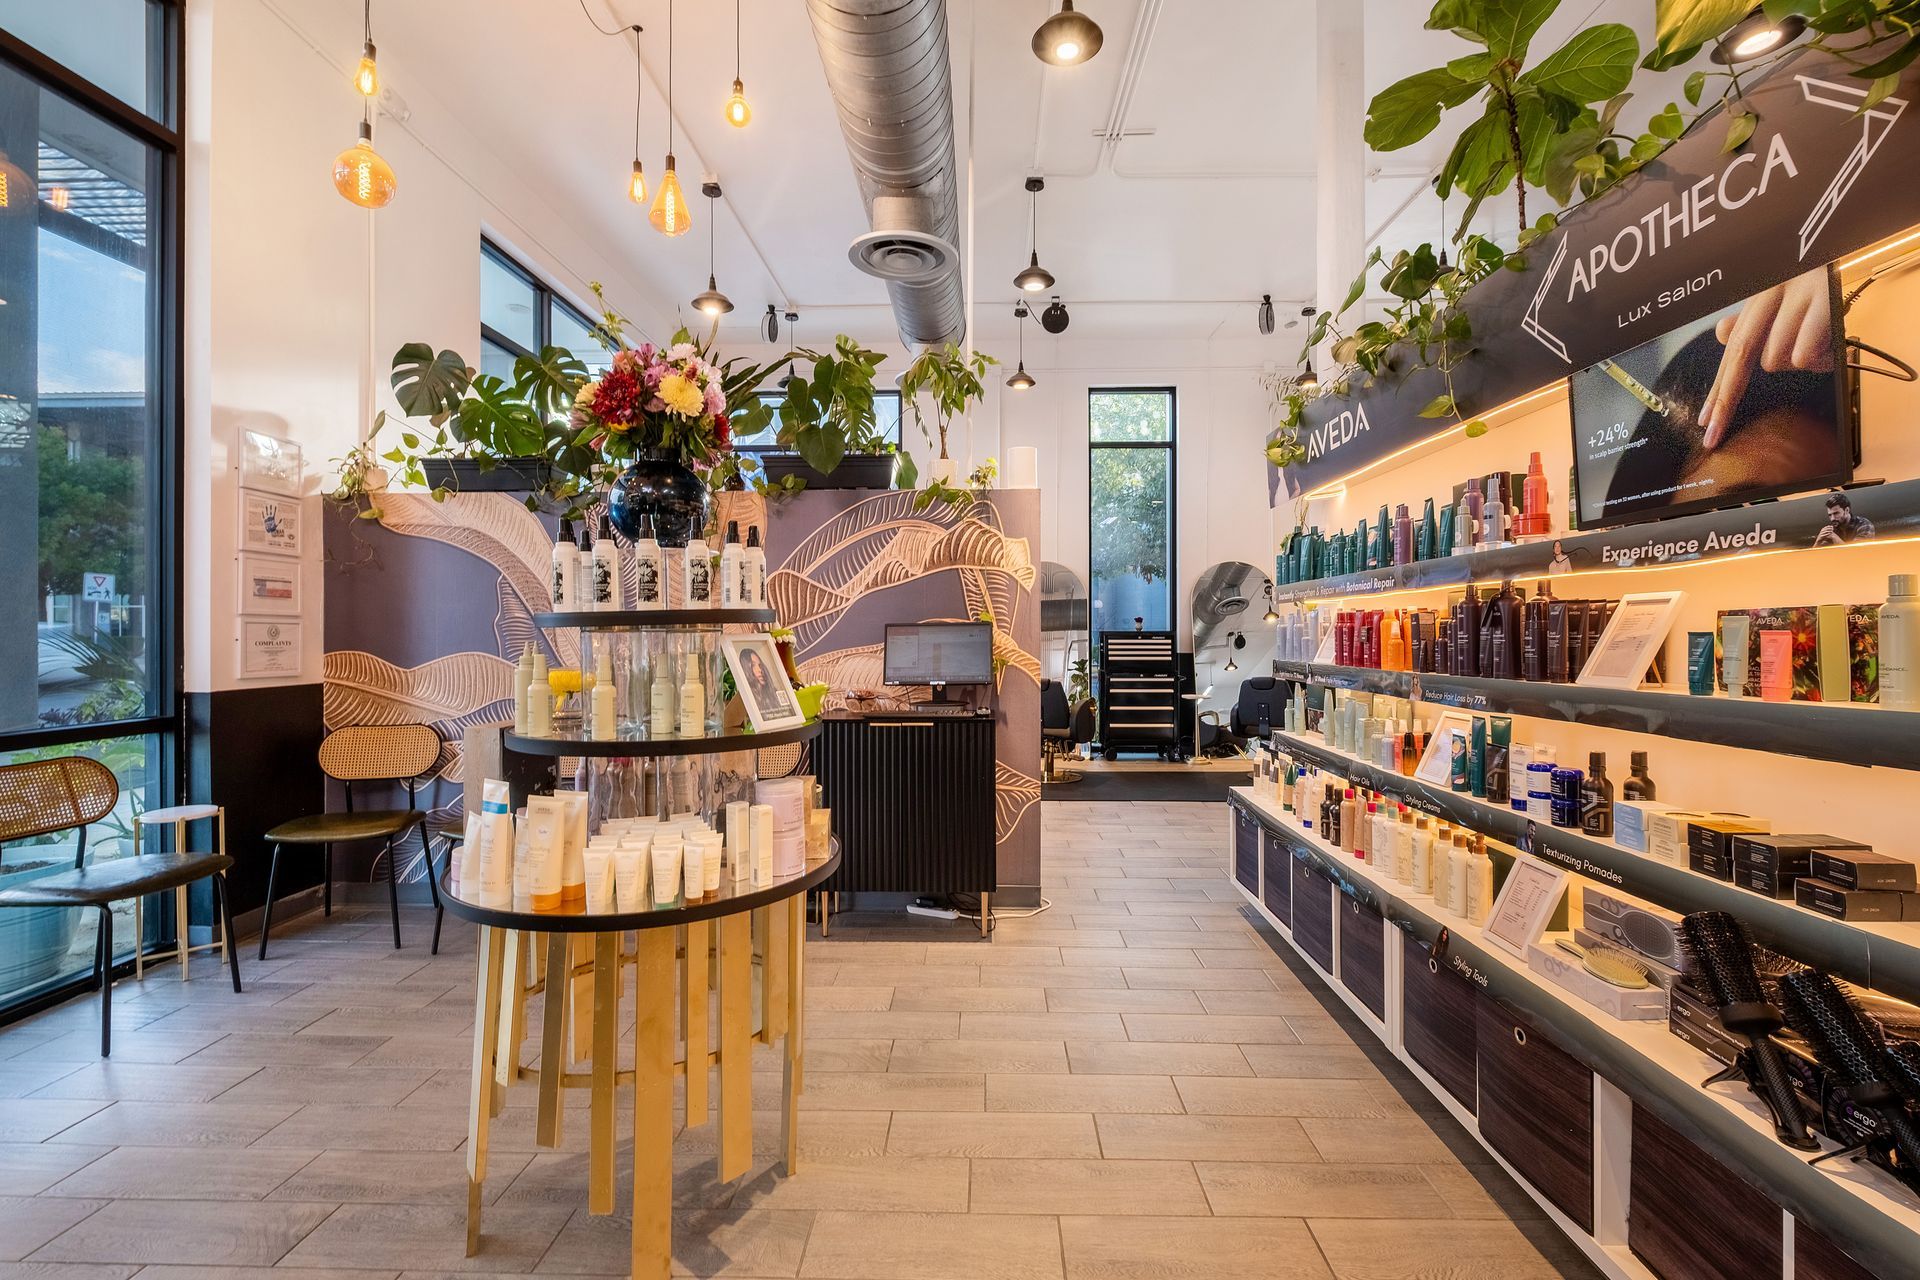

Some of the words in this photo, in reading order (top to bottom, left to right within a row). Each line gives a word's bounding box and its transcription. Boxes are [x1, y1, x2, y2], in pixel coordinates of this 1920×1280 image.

[1567, 132, 1799, 304] APOTHECA
[1618, 301, 1652, 328] Lux
[1657, 268, 1723, 309] Salon
[1306, 401, 1371, 464] AVEDA
[1588, 421, 1629, 448] +24%
[1594, 449, 1608, 459] scalp
[1607, 444, 1624, 455] barrier
[1601, 539, 1699, 565] Experience
[1703, 522, 1777, 551] Aveda
[1346, 577, 1373, 593] Botanical
[1373, 576, 1395, 591] Repair
[1756, 617, 1784, 625] AVEDA
[1849, 614, 1872, 622] EDA
[1425, 689, 1443, 700] Reduce
[1443, 691, 1454, 701] Hair
[1454, 693, 1466, 703] Loss
[1466, 694, 1474, 706] by
[1474, 695, 1487, 705] 77%
[1349, 773, 1361, 782] Hair
[1361, 777, 1370, 786] Oils
[1405, 794, 1422, 809] Styling
[1422, 799, 1441, 814] Creams
[1542, 843, 1582, 871] Texturizing
[1583, 859, 1623, 884] Pomades
[1453, 955, 1473, 978] Styling
[1472, 968, 1489, 987] Tools
[1677, 1005, 1691, 1017] ergo
[1676, 1028, 1690, 1041] ergo
[1787, 1073, 1804, 1088] rgo
[1853, 1109, 1876, 1128] ergo
